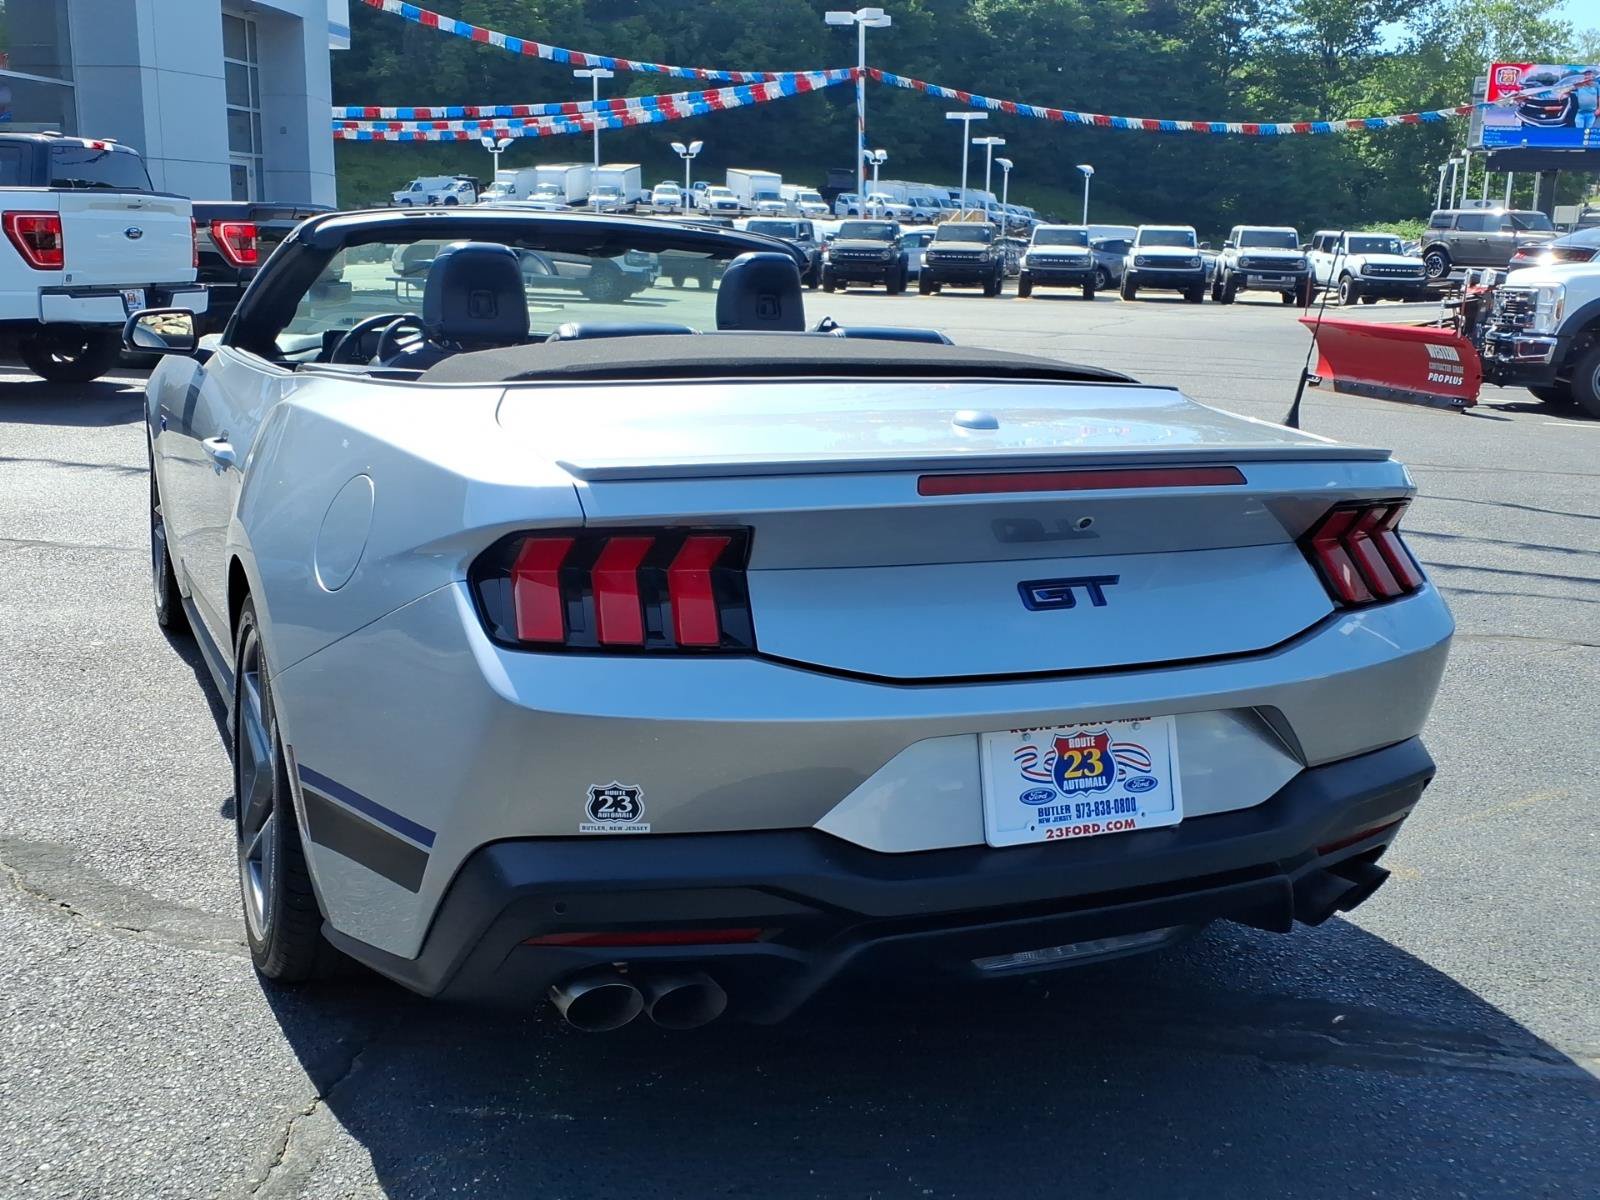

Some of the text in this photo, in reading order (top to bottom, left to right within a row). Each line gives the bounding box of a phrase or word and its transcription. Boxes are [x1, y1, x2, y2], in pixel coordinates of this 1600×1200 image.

[1017, 574, 1120, 612] GT
[1068, 736, 1096, 749] ROUTE
[1063, 748, 1104, 779] 23
[1063, 776, 1108, 791] AUTOMALL
[598, 796, 633, 812] 23
[1037, 796, 1138, 819] BUTLER 973-838-0800
[1045, 818, 1137, 840] 23FORD.COM
